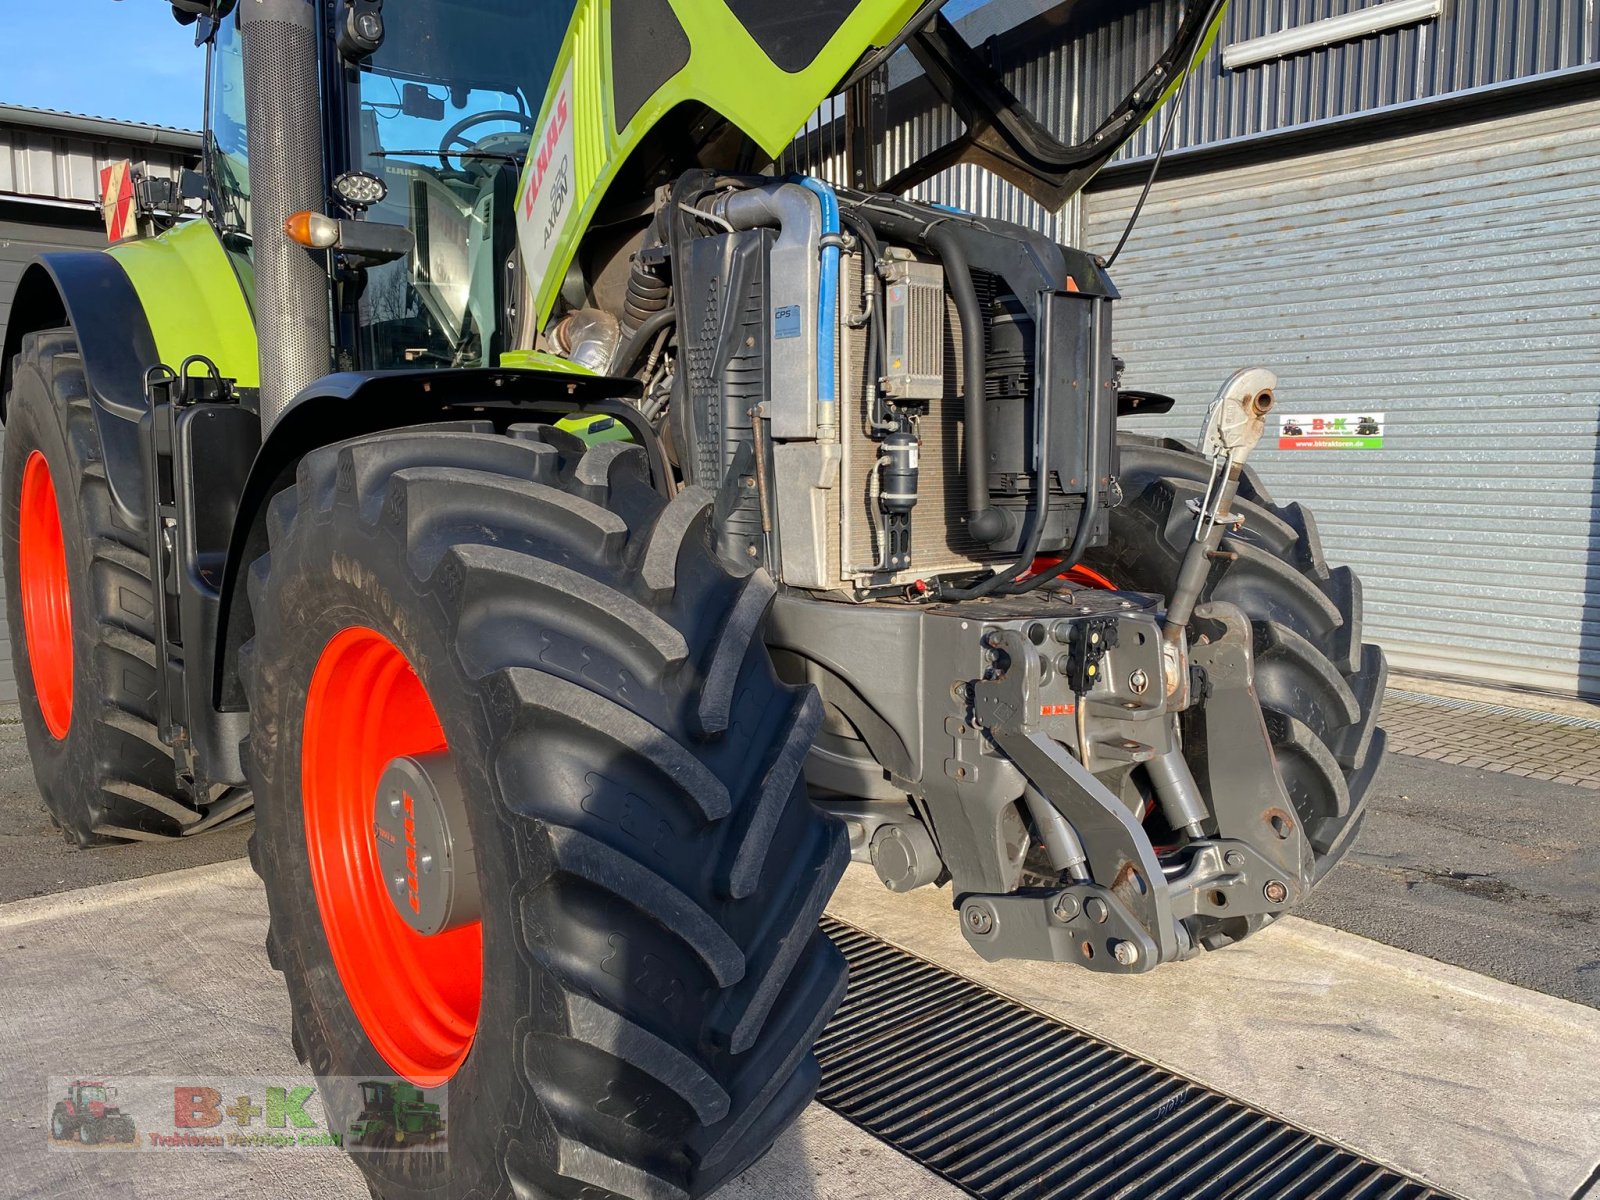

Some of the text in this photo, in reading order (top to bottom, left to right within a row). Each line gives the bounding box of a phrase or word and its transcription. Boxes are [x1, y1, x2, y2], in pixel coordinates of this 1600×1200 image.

[525, 90, 568, 222] CLAAS
[543, 179, 569, 249] AXION
[1312, 418, 1347, 430] B+K
[402, 788, 420, 915] CLAAS
